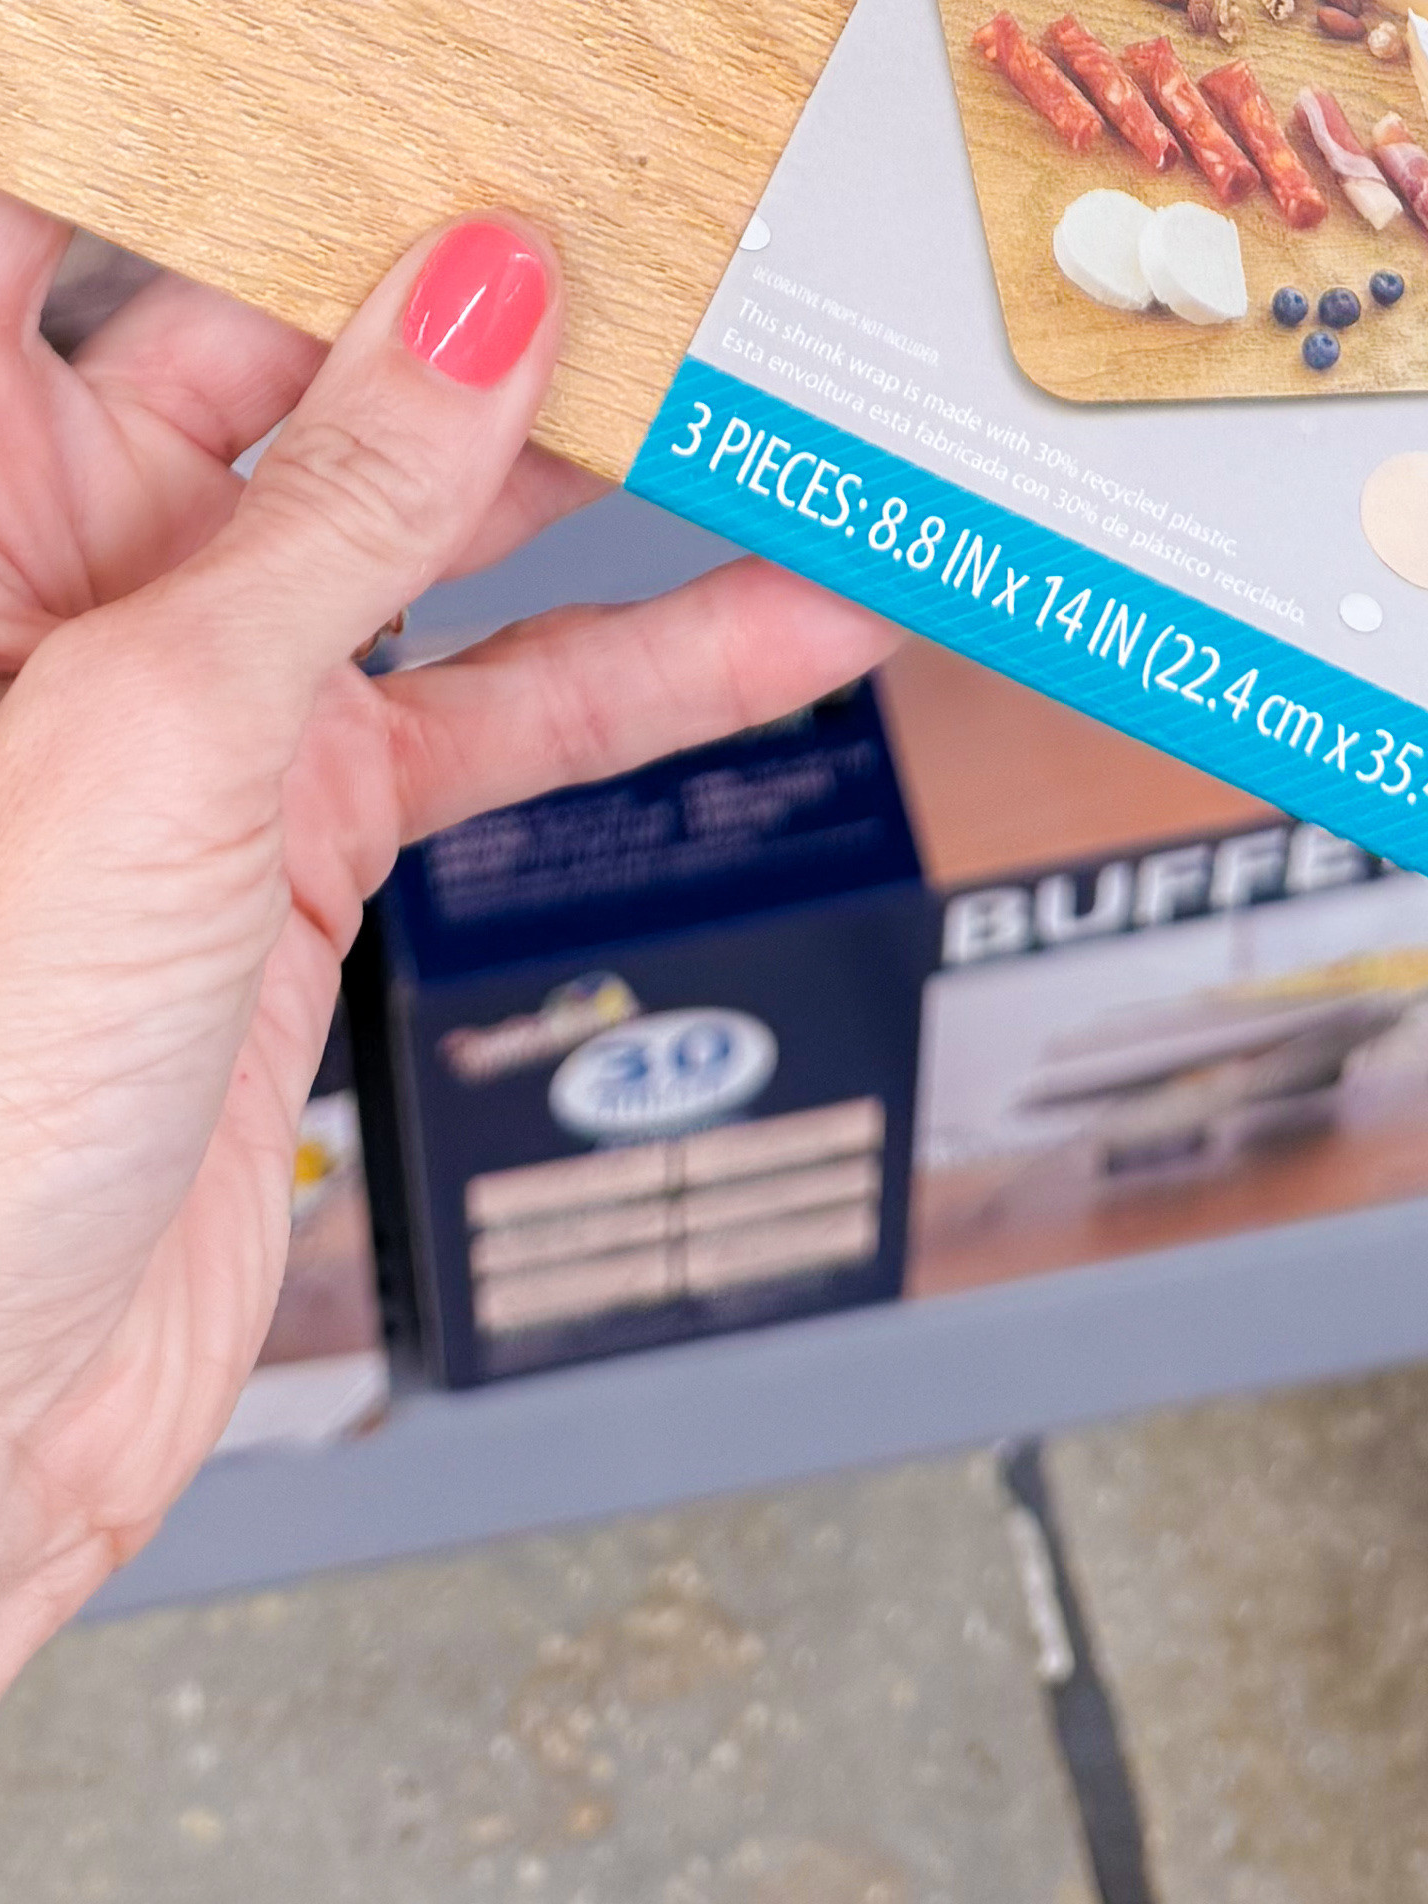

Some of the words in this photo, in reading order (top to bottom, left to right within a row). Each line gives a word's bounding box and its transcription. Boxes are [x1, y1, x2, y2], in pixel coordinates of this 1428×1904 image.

[721, 328, 764, 364] Esta
[768, 355, 865, 414] envoltura
[868, 400, 912, 435] está
[914, 420, 1009, 483] fabricada
[1011, 472, 1050, 502] con
[1052, 488, 1098, 525] 30%
[1101, 511, 1130, 539] de
[1129, 526, 1211, 580] plástico
[1213, 567, 1306, 627] reciclado.
[736, 297, 779, 333] This
[782, 322, 844, 367] shrink
[849, 355, 900, 396] wrap
[904, 377, 920, 403] is
[923, 392, 983, 433] made
[986, 420, 1031, 456] with
[1034, 442, 1079, 479] 30%
[1081, 469, 1169, 522] recycled
[1168, 507, 1238, 558] plastic.
[671, 400, 713, 456] 3
[708, 415, 869, 540] PIECES:
[868, 495, 947, 571] 8.8
[941, 528, 1002, 599] IN
[991, 567, 1030, 617] x
[1034, 574, 1093, 645] 14
[1086, 598, 1147, 671] IN
[1141, 624, 1259, 723] (22.4
[1255, 692, 1324, 759] cm
[1323, 723, 1361, 774] x
